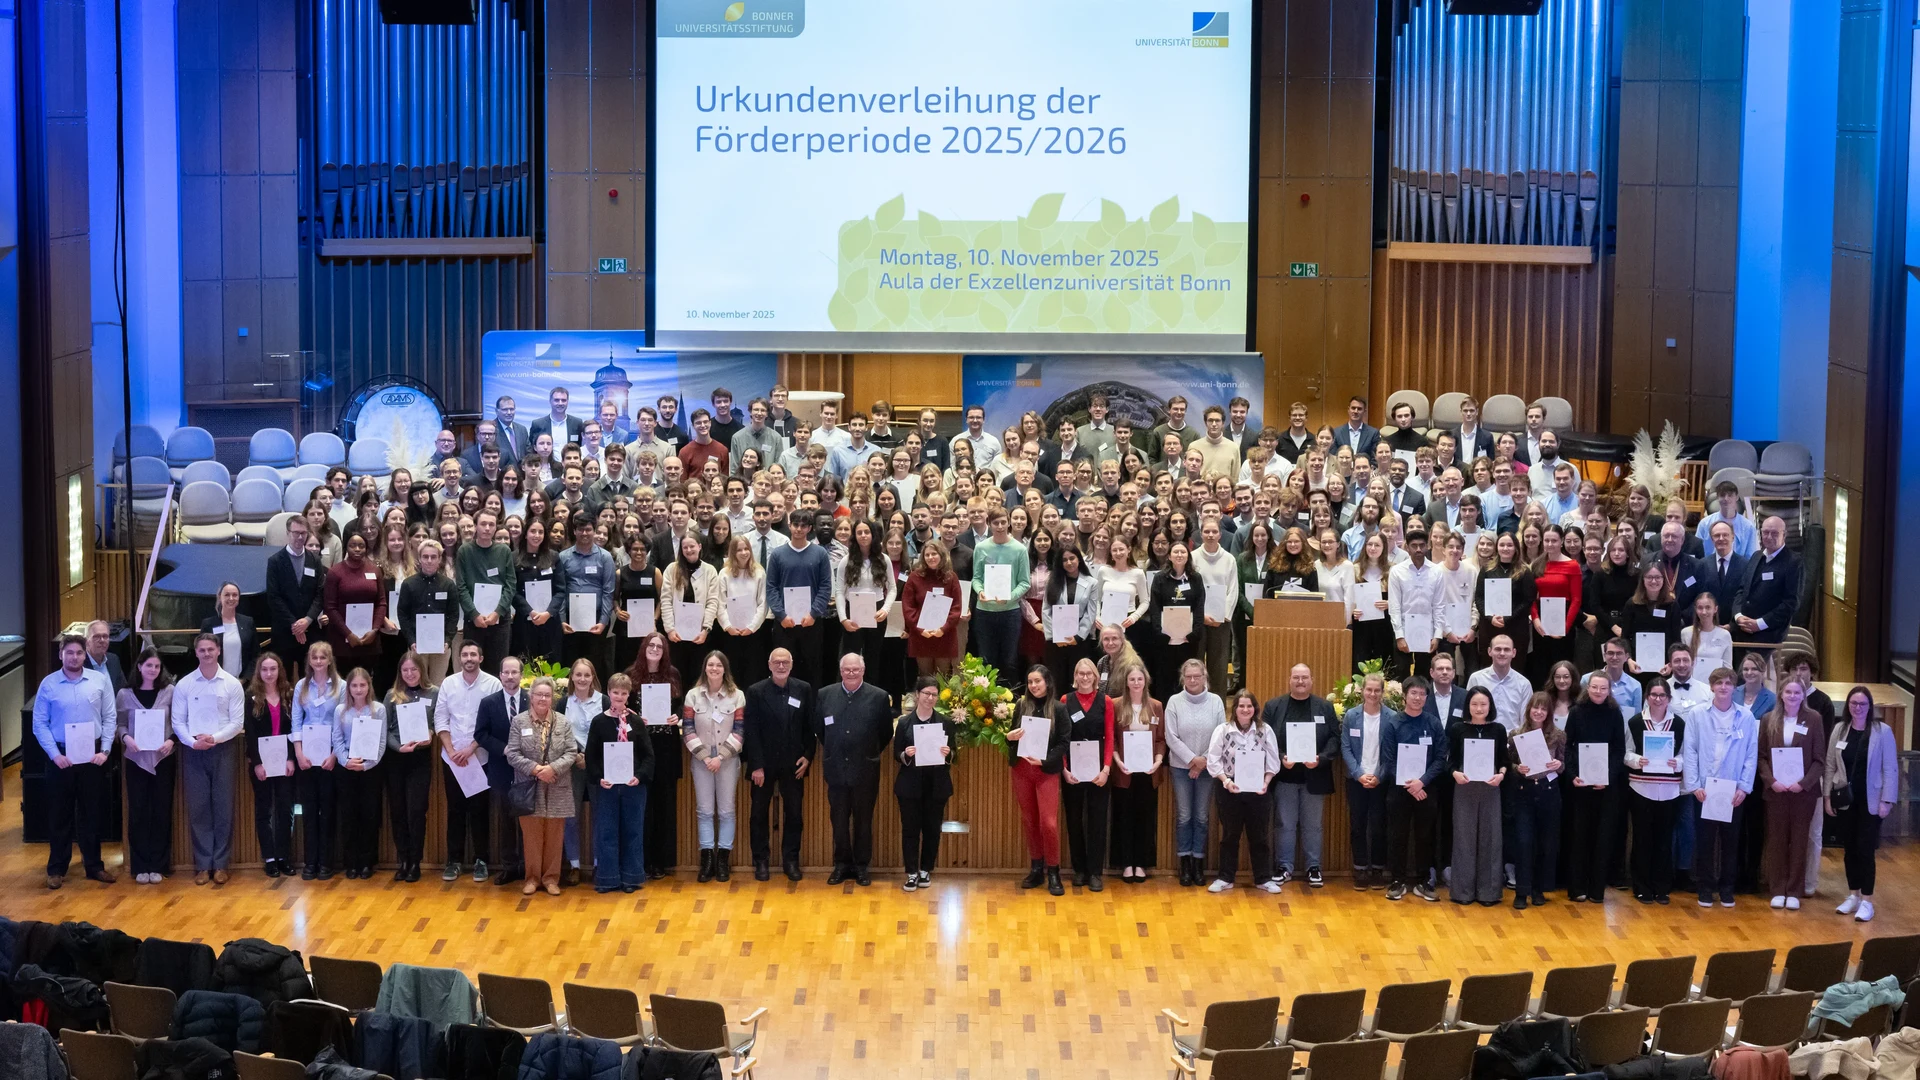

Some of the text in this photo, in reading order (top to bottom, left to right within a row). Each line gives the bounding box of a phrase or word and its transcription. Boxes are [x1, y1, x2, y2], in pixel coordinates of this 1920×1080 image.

[752, 12, 794, 21] BONNER
[675, 24, 794, 33] UNIVERSITÄTSSTIFTUNG
[1135, 37, 1219, 47] UNIVERSITÄT BONN
[695, 85, 1101, 120] Urkundenverleihung der
[695, 125, 1127, 160] Förderperiode 2025/2026
[880, 249, 1160, 270] Montag, 10. November 2025
[879, 272, 1231, 293] Aula der Exzellenzuniversität Bonn
[686, 310, 775, 319] 10. November 2025
[386, 394, 412, 404] ADAMS
